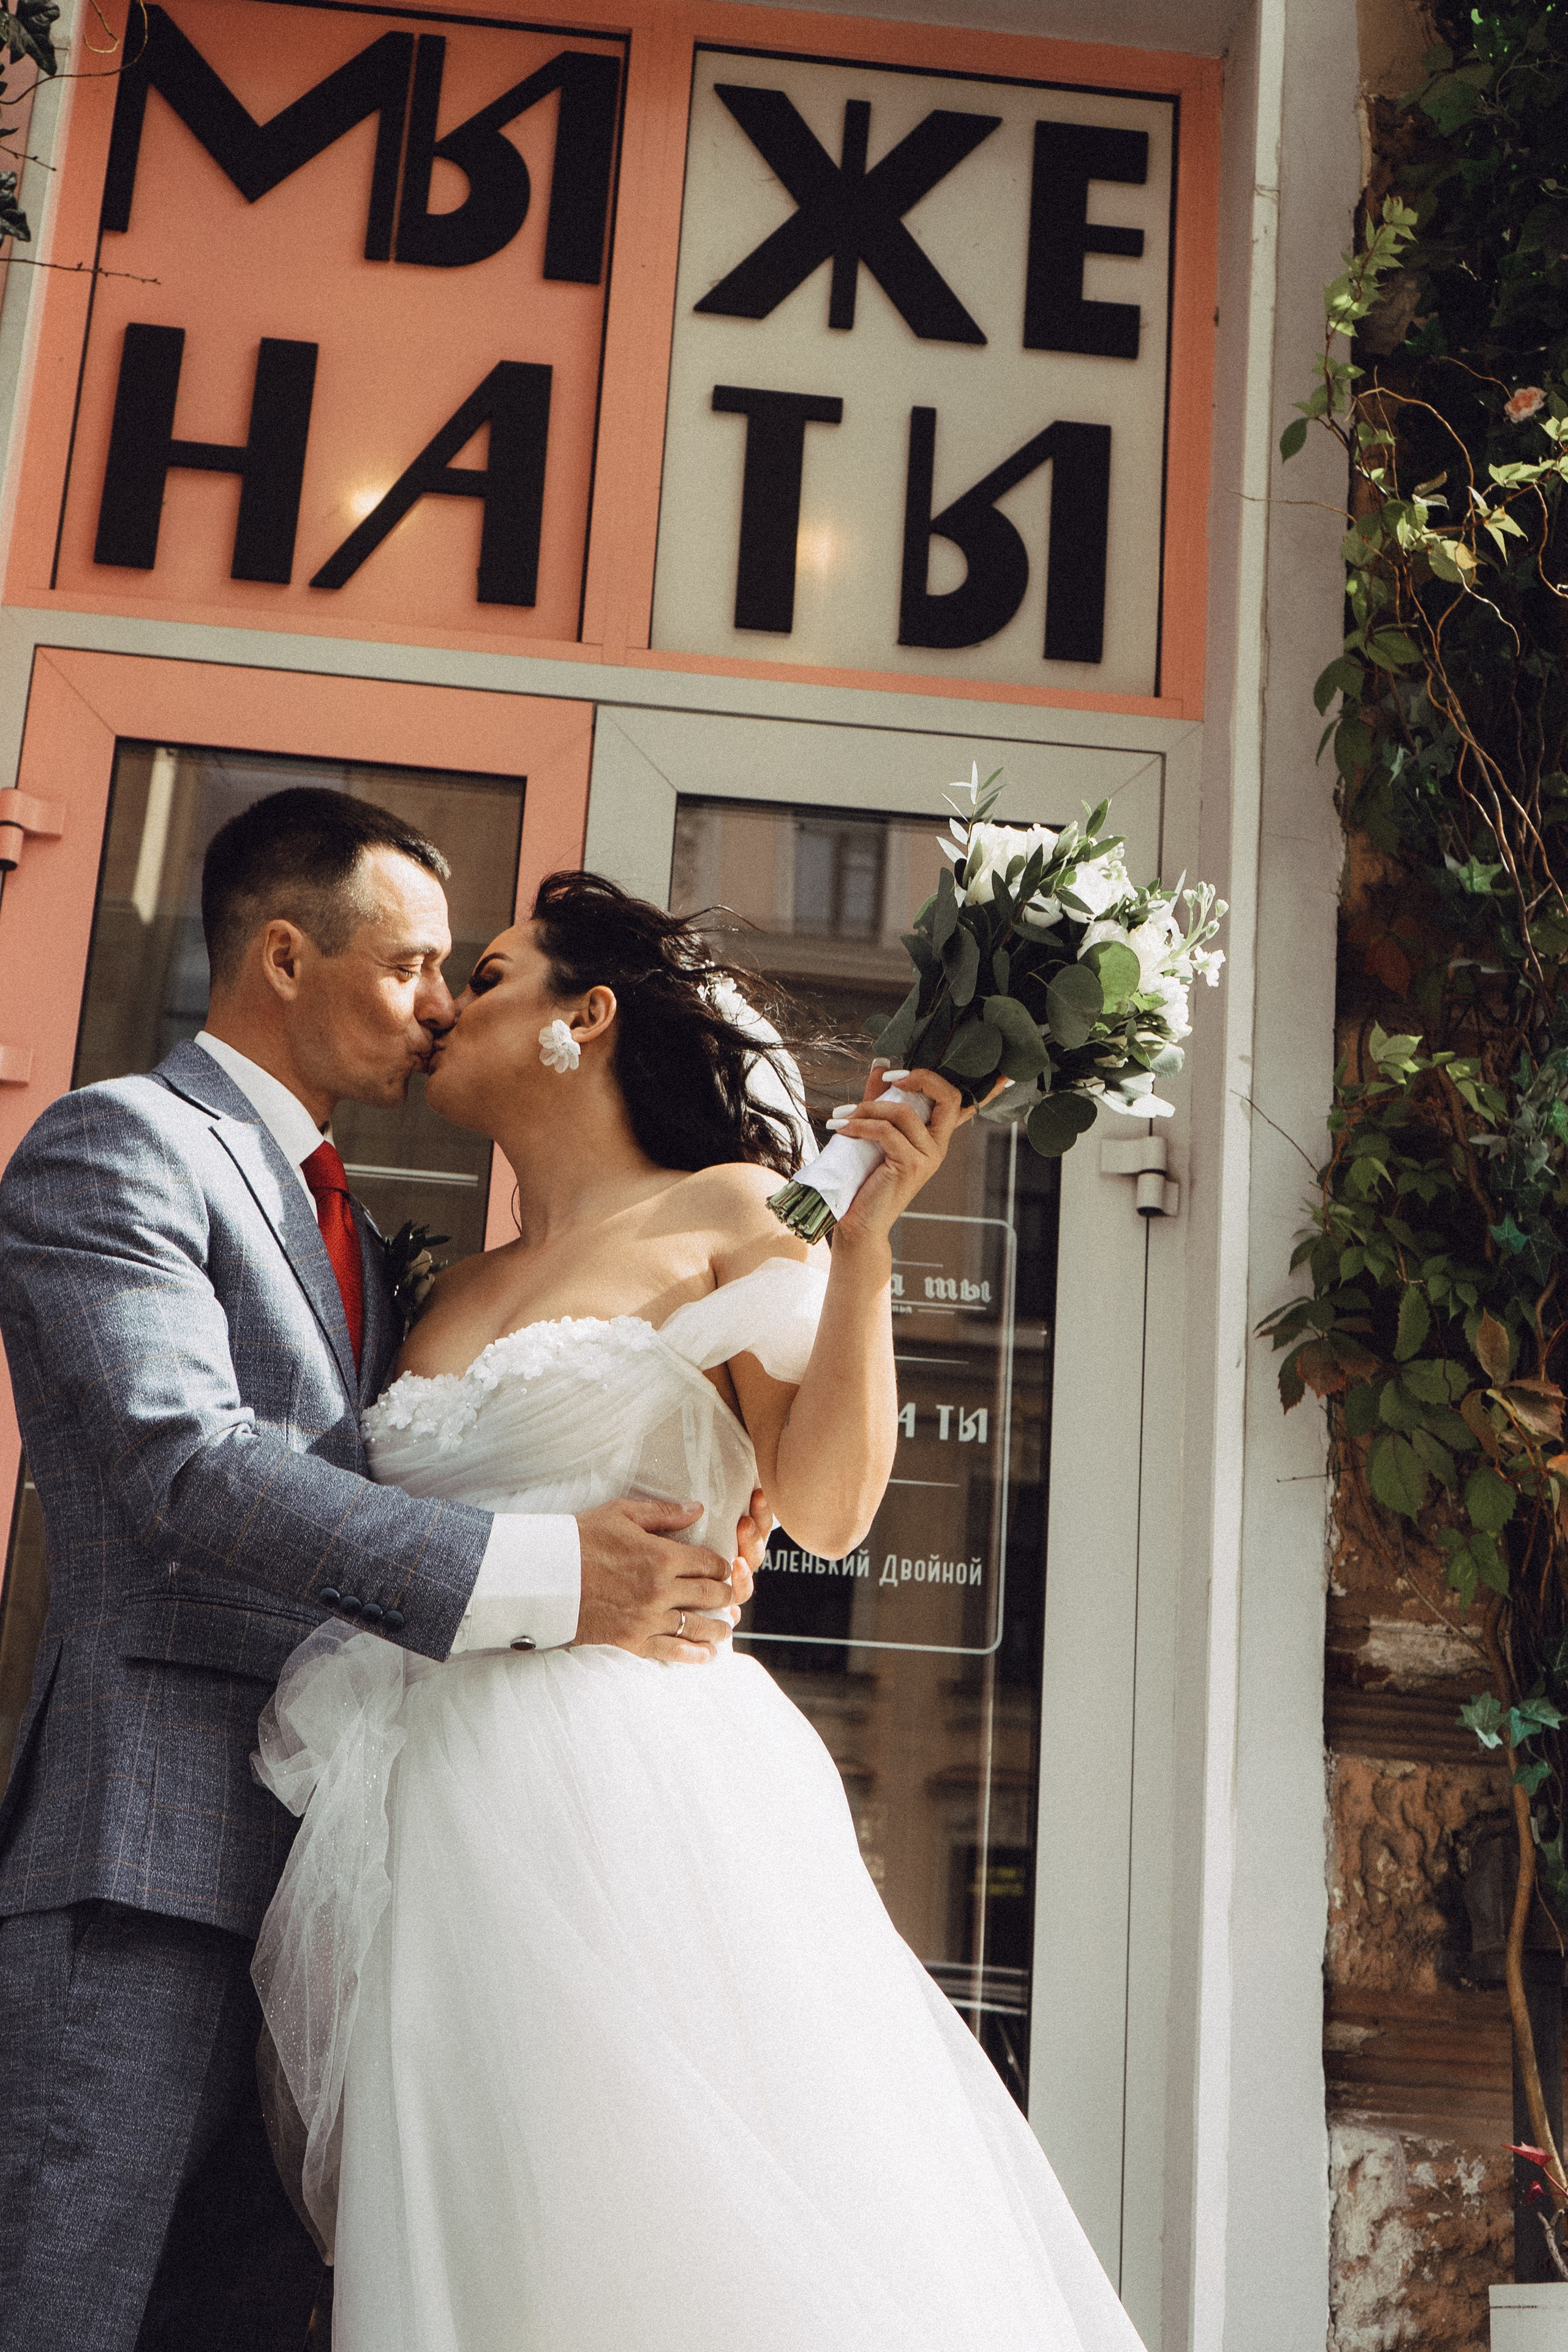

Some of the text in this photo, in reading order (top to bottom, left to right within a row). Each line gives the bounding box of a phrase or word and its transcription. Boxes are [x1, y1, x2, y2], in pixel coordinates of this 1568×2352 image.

[102, 2, 1149, 360] МЫ ЖЕ
[93, 322, 1112, 664] НА ТЫ
[892, 1273, 905, 1297] а
[898, 1401, 989, 1444] А ТЫ
[754, 1548, 870, 1578] АЛЕНЬКИЙ
